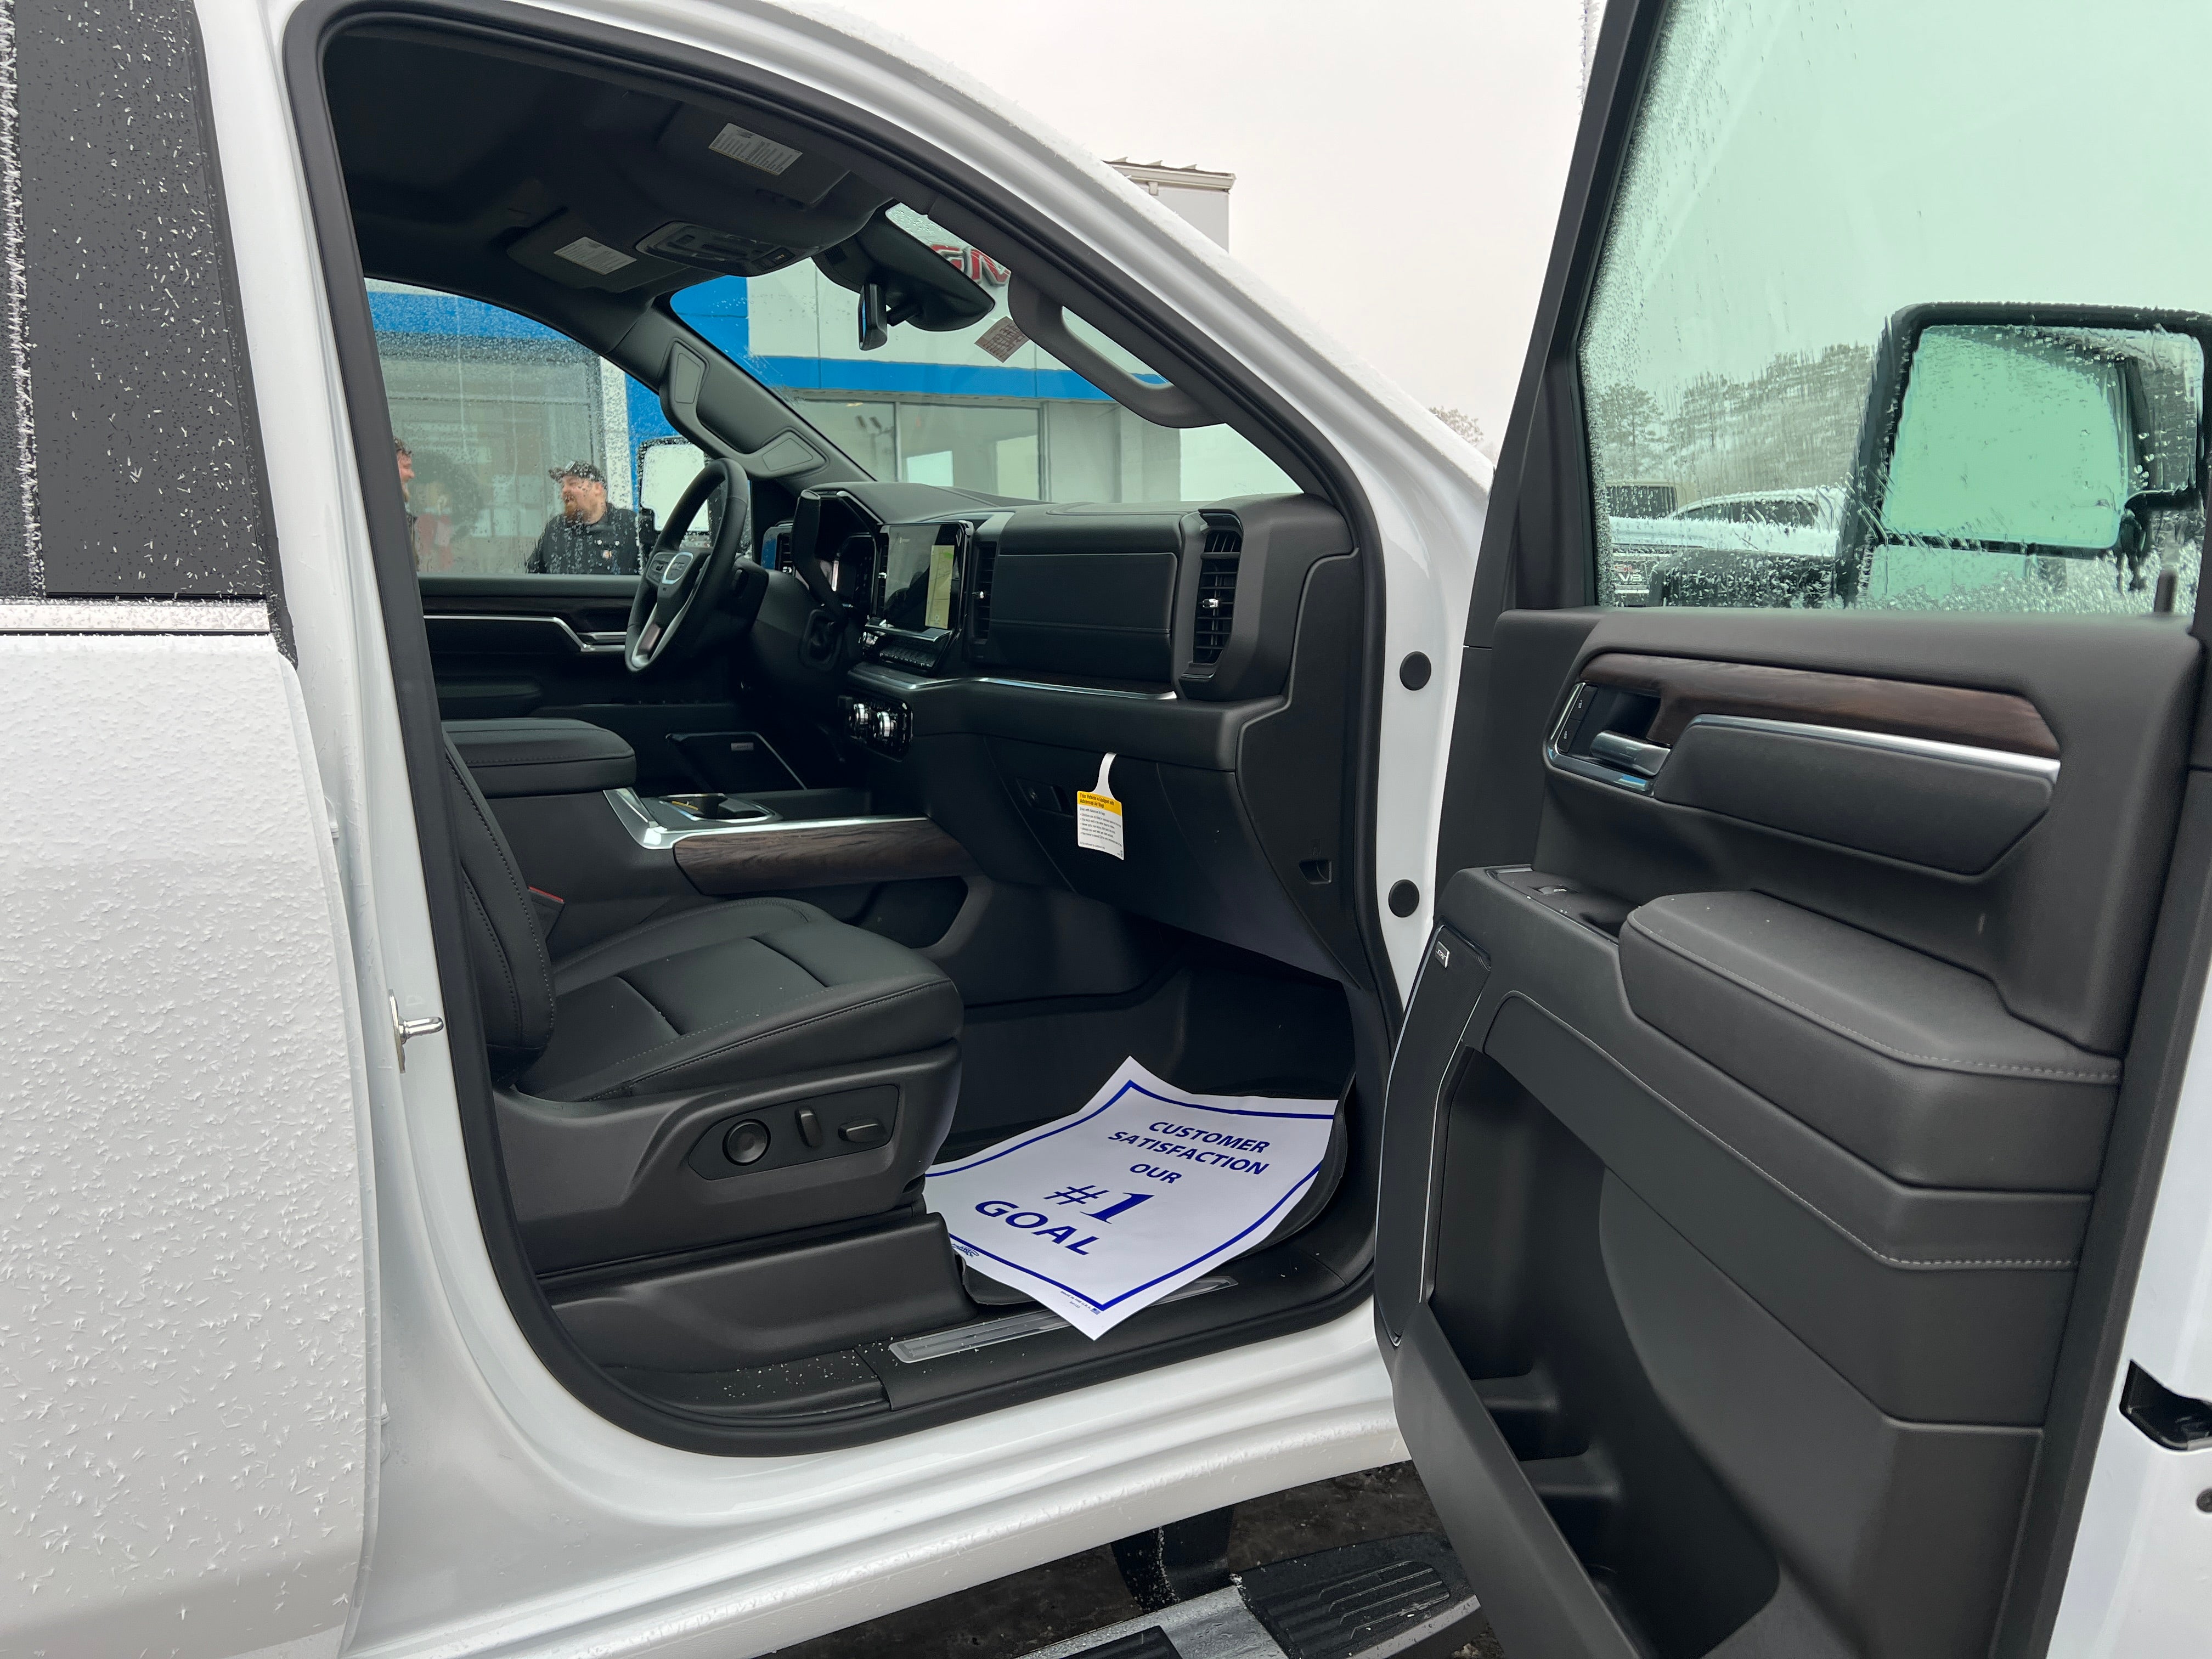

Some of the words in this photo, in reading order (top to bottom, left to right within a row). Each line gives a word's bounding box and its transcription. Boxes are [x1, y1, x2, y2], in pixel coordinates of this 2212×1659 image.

[1108, 1131, 1270, 1175] SATISFACTION
[1148, 1121, 1270, 1154] CUSTOMER
[1129, 1163, 1182, 1184] OUR
[1044, 1184, 1155, 1224] #1
[975, 1200, 1099, 1255] GOAL
